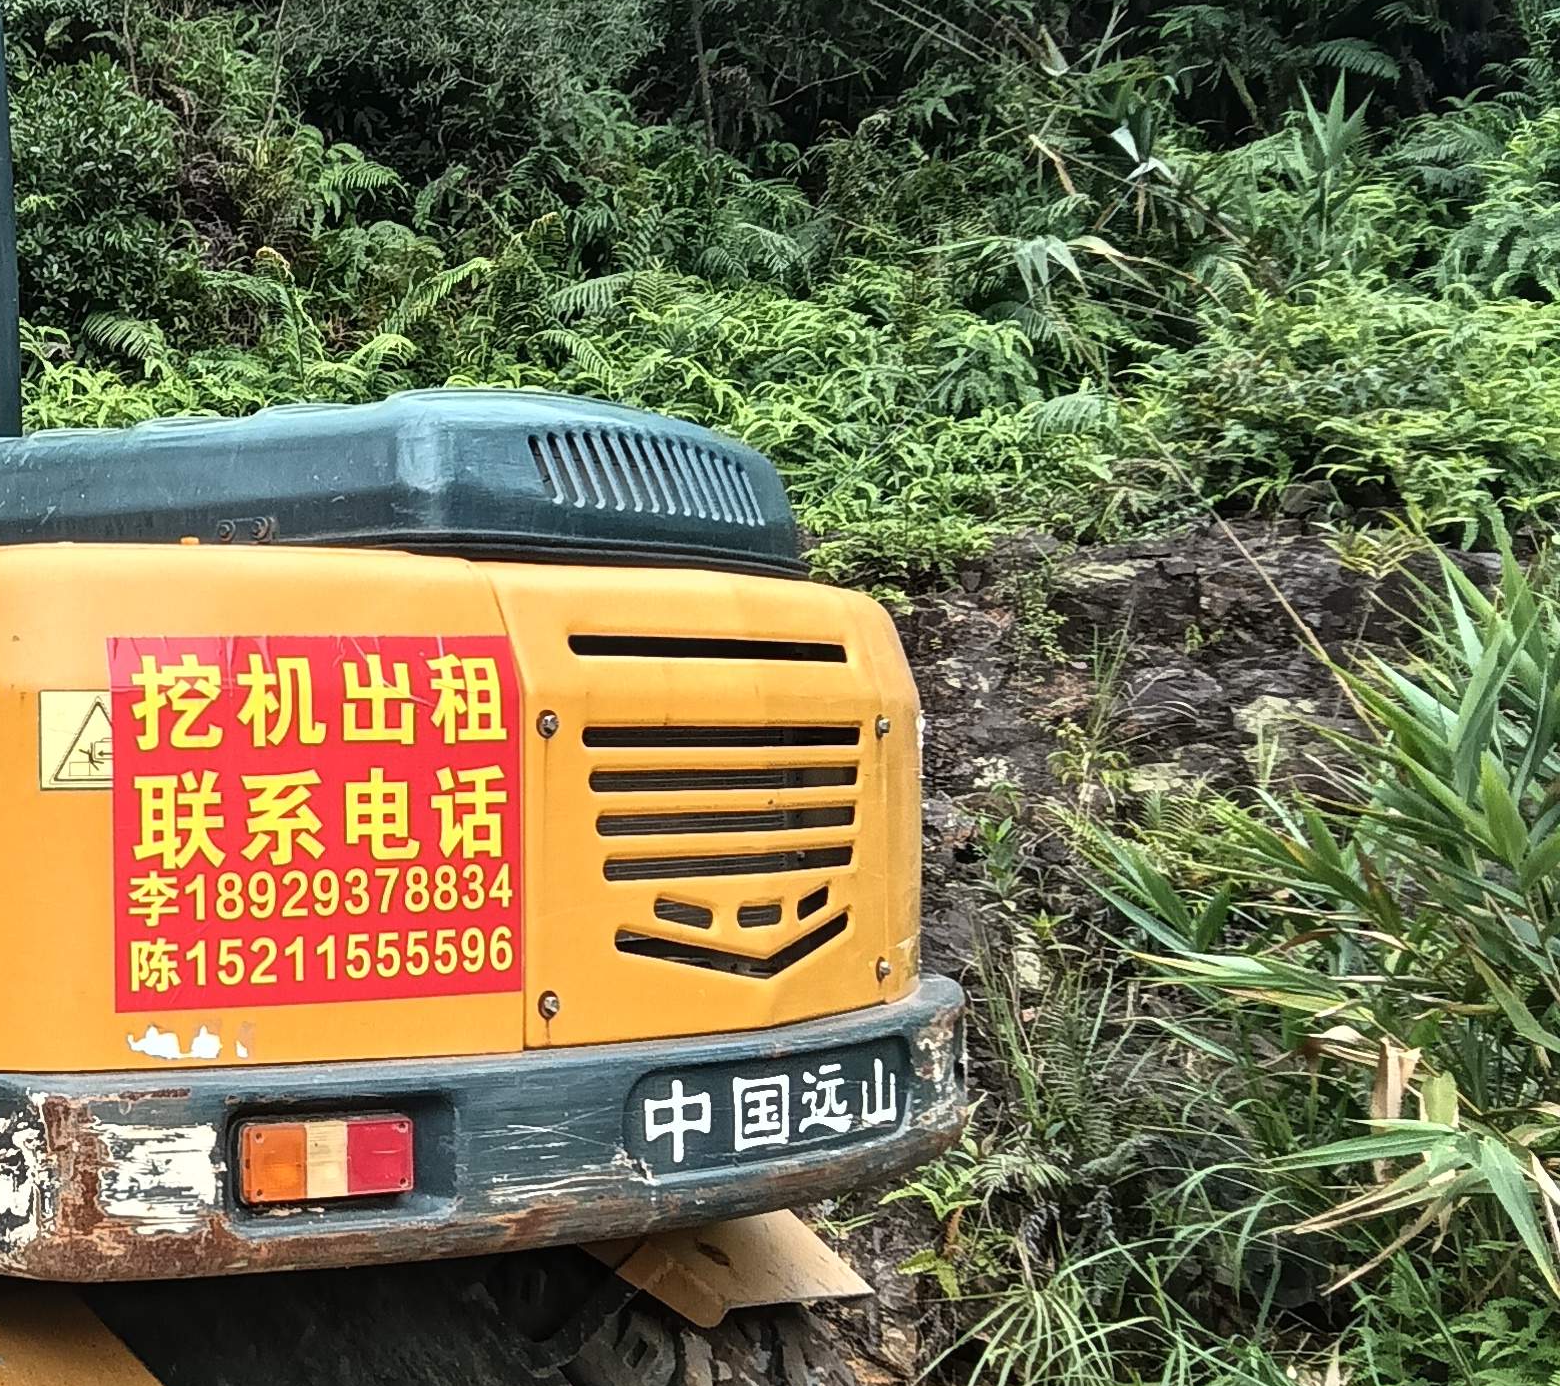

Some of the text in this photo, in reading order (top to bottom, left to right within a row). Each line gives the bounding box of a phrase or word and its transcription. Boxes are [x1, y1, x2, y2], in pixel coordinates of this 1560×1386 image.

[131, 654, 508, 751] 挖机出租
[133, 766, 508, 870] 联系电话
[128, 863, 513, 928] 李18929378834
[130, 926, 513, 992] 陈15211555596
[644, 1059, 897, 1163] 中国远山
